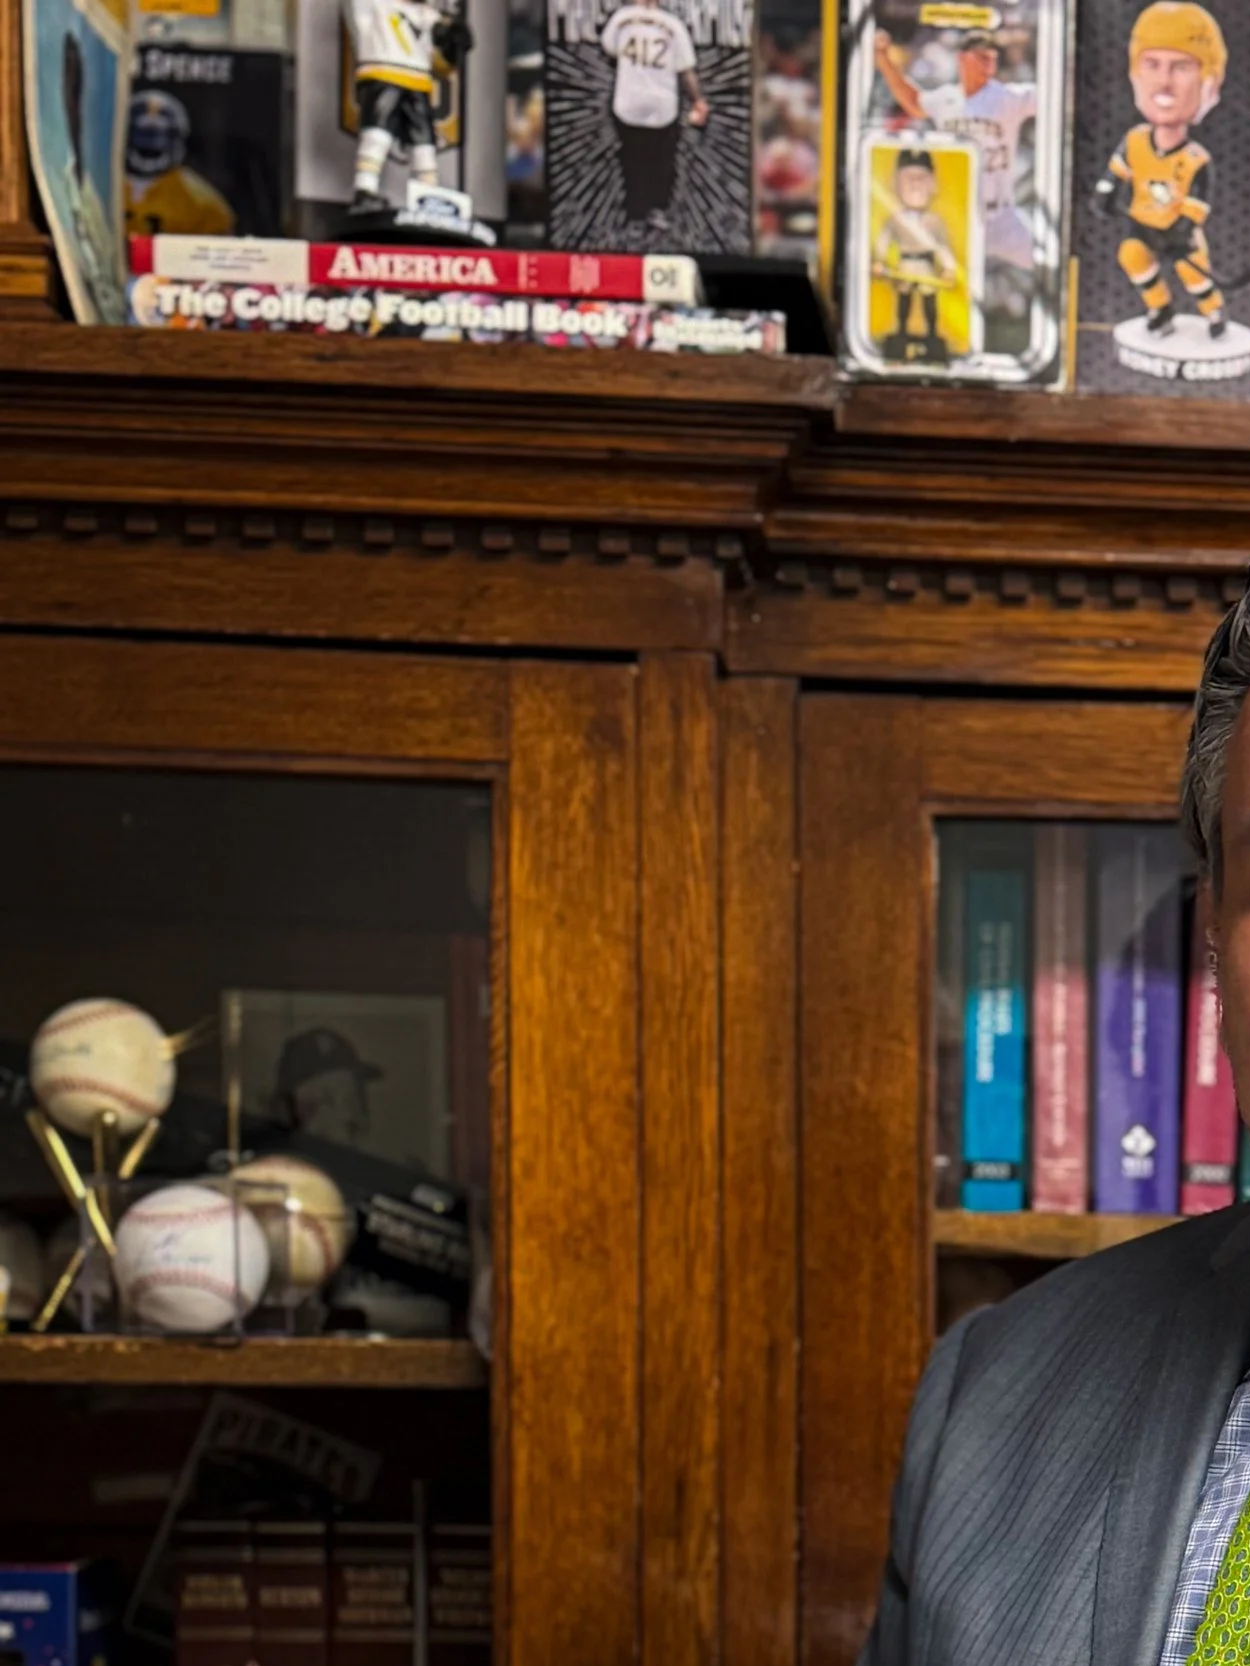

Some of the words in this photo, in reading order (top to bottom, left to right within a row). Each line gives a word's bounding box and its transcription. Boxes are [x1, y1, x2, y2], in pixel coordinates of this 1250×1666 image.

[624, 38, 668, 69] 412
[328, 245, 498, 288] AMERICA
[156, 284, 227, 318] The
[232, 286, 373, 332] College
[375, 290, 529, 332] Football
[532, 301, 628, 338] Book
